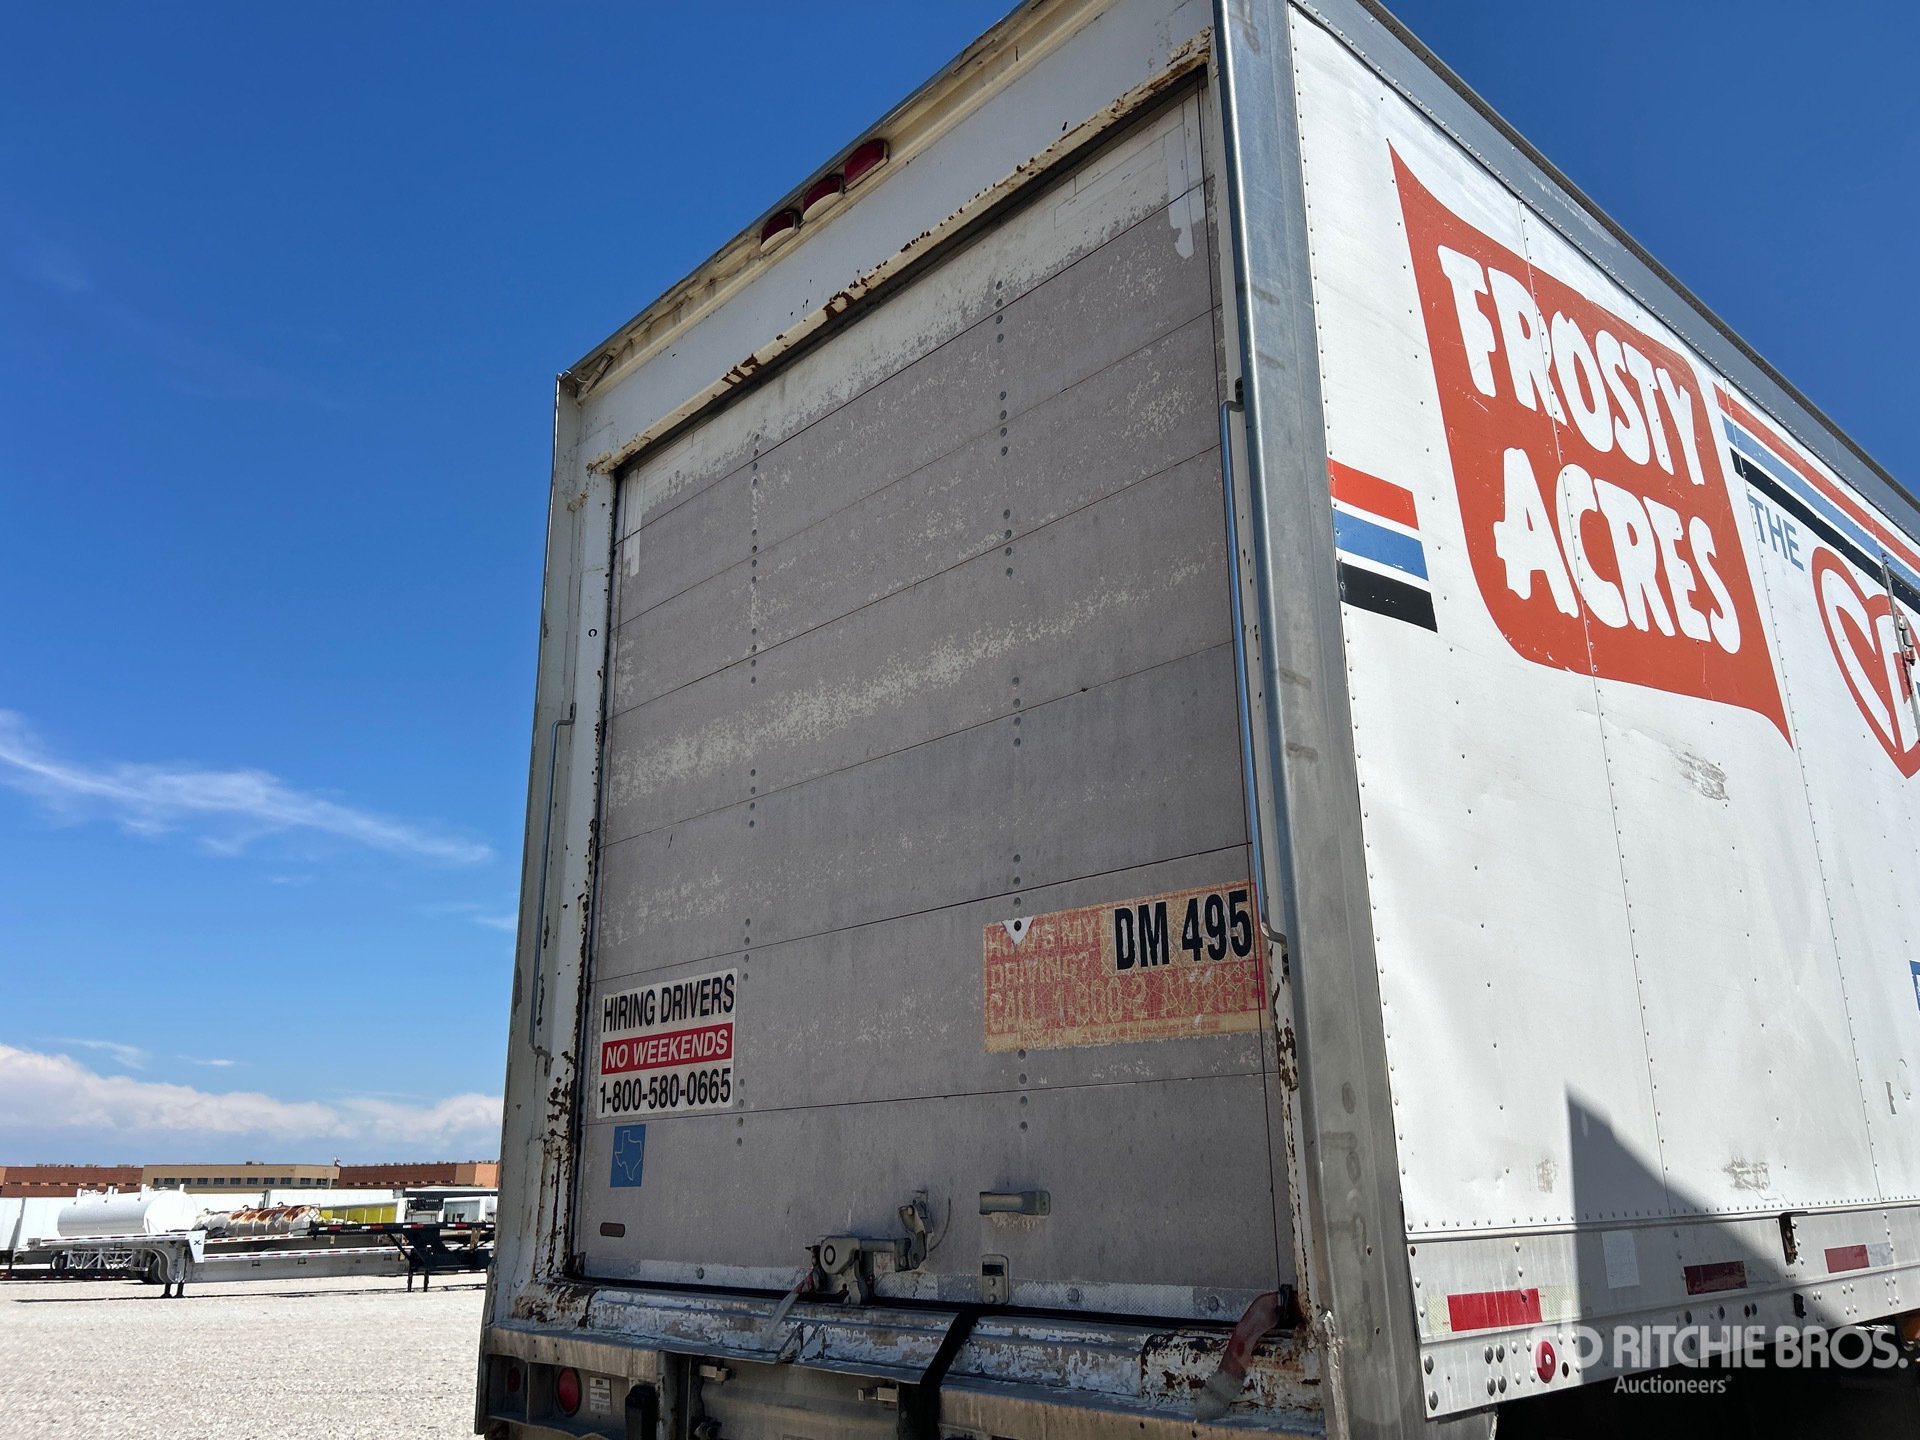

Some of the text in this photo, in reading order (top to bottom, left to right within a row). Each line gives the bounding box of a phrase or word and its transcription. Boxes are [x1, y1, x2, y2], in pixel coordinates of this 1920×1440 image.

[1437, 245, 1705, 486] FROSTY
[1493, 447, 1741, 654] ACRES
[1748, 494, 1805, 572] THE
[1114, 889, 1252, 970] DM 495
[603, 974, 735, 1032] HIRING DRIVERS
[605, 1029, 727, 1069] NO WEEKENDS
[600, 1068, 731, 1113] 1-800-580-0665
